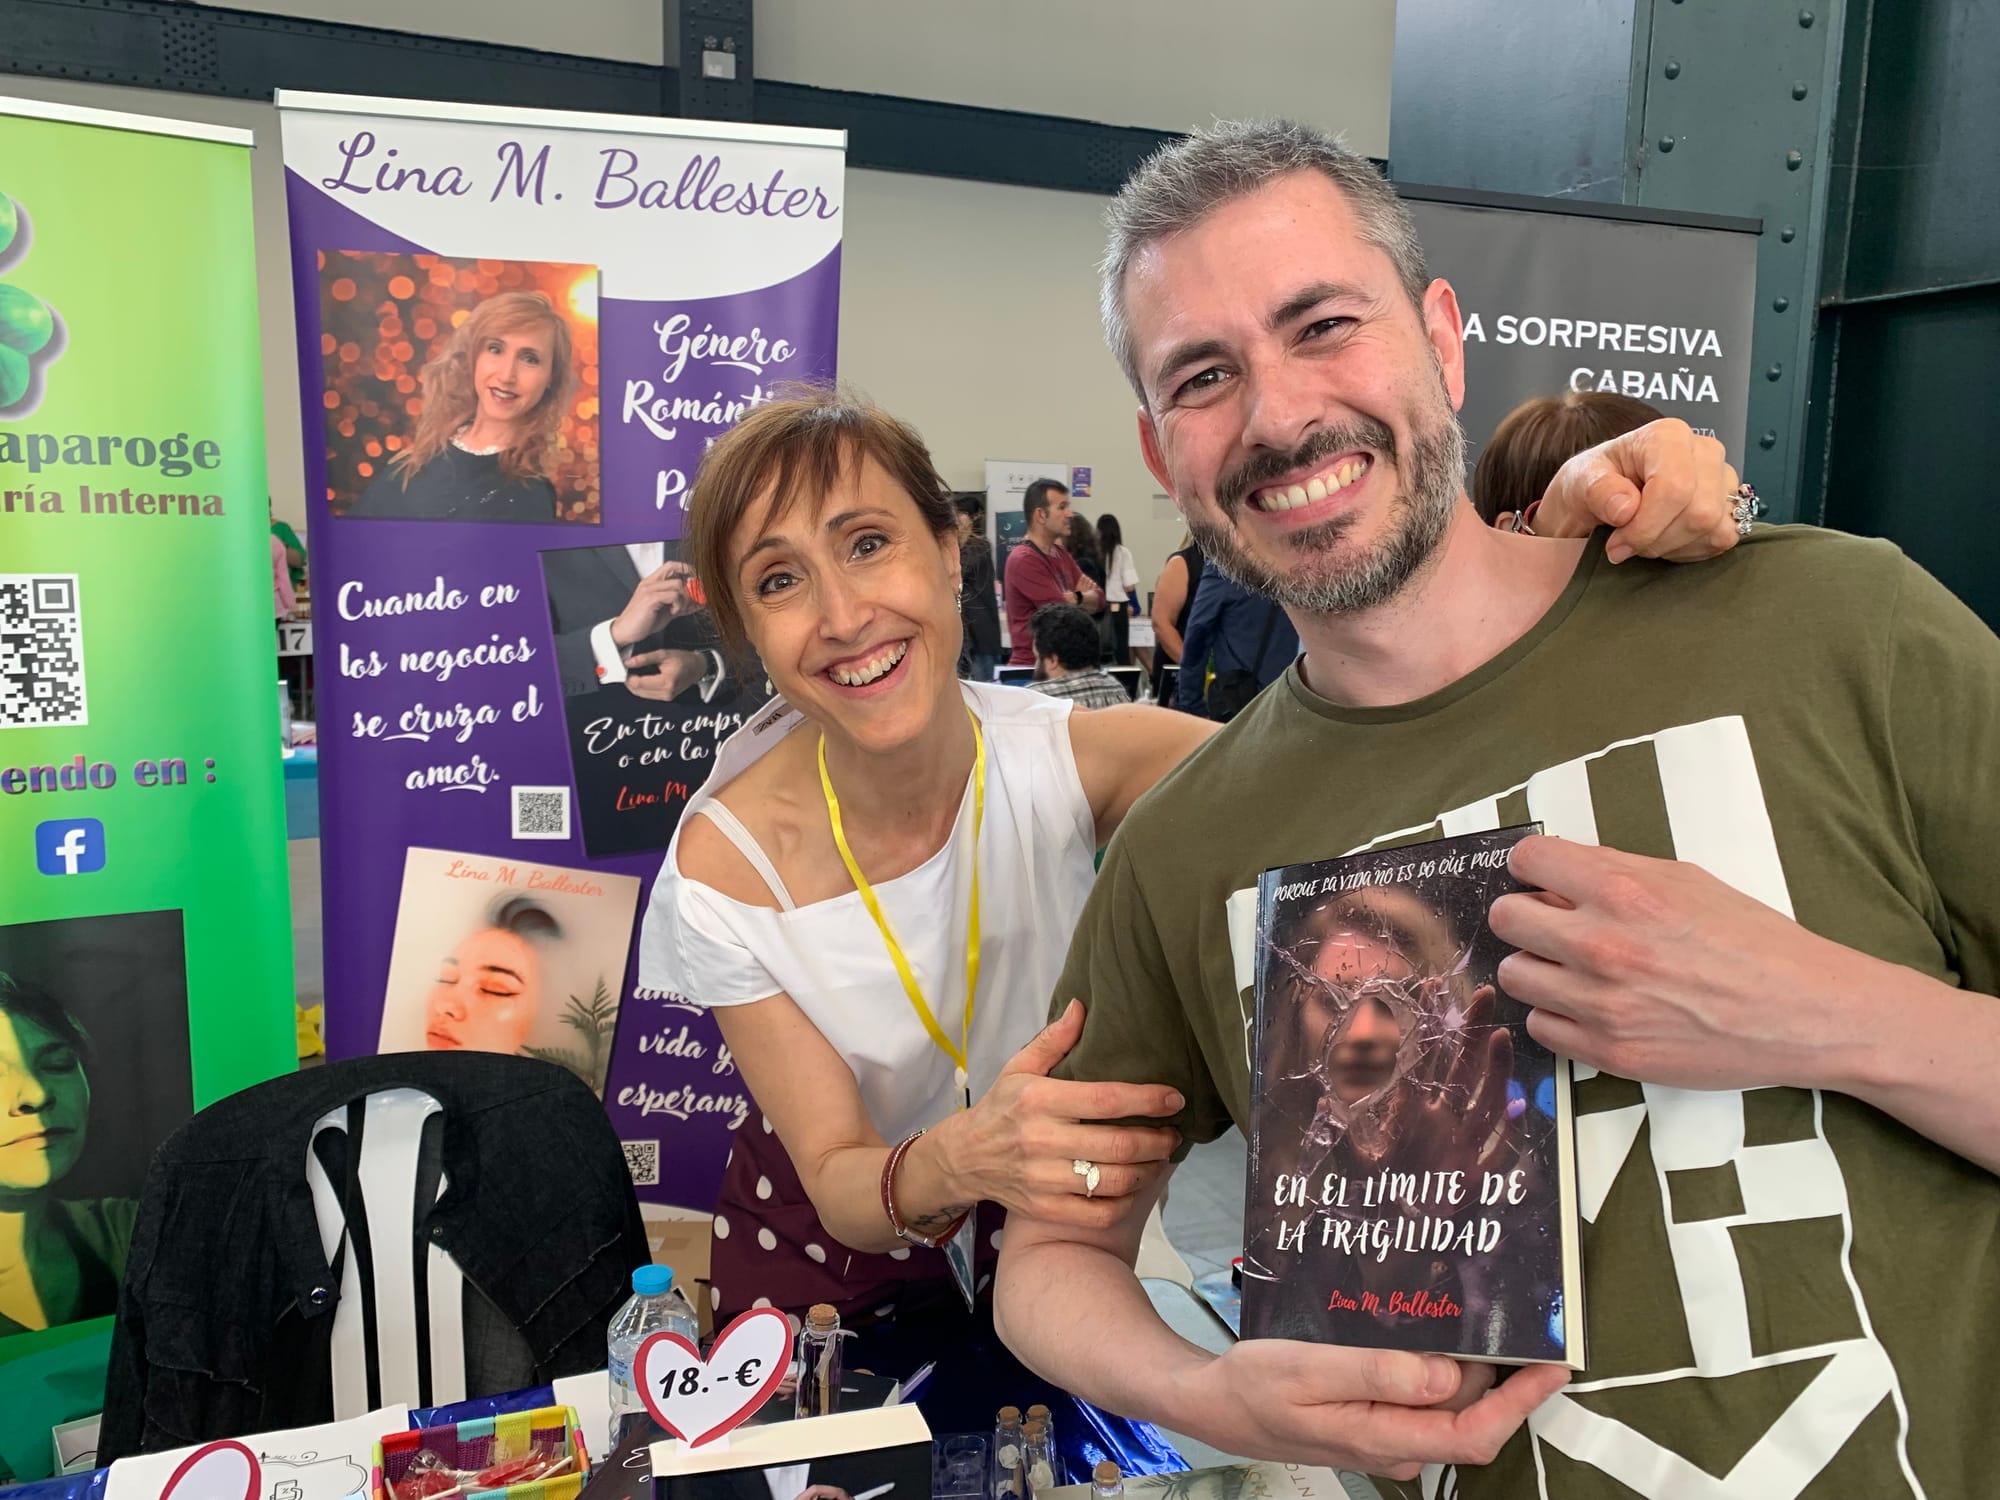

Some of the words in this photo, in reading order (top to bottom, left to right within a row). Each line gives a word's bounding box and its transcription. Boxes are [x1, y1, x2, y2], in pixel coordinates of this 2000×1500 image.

[322, 131, 472, 195] Lina
[490, 141, 563, 205] M.
[594, 148, 838, 220] Ballester
[653, 314, 796, 383] Género
[1462, 313, 1487, 342] A
[1496, 315, 1723, 357] SORPRESIVA
[1570, 367, 1720, 402] CABAÑA
[0, 484, 64, 514] ría
[79, 485, 226, 516] Interna
[337, 576, 469, 621] Cuando
[479, 584, 520, 608] en
[279, 628, 306, 651] 17
[340, 643, 388, 679] los
[400, 634, 537, 682] negocios
[352, 712, 388, 738] se
[398, 703, 501, 743] cruza
[512, 684, 544, 722] el
[583, 716, 636, 755] En
[635, 713, 675, 740] tu
[639, 747, 673, 766] en
[680, 737, 710, 761] la
[134, 758, 187, 787] en
[405, 755, 500, 794] amor.
[445, 860, 491, 881] Lina
[527, 869, 605, 897] Ballester
[1272, 879, 1321, 902] PORQUE
[1338, 867, 1372, 891] VIDA
[1373, 867, 1394, 887] NO
[1397, 863, 1414, 883] ES
[1438, 853, 1467, 876] QUE
[638, 1025, 707, 1059] vida
[617, 1082, 750, 1130] esperanz
[1274, 1173, 1308, 1207] EN
[1322, 1173, 1350, 1207] EL
[1362, 1167, 1467, 1207] LÍMITE
[1480, 1170, 1528, 1206] DE
[1276, 1220, 1307, 1253] LA
[1321, 1216, 1503, 1263] FRAGILIDAD
[1328, 1290, 1358, 1312] Lina
[1389, 1291, 1463, 1318] Ballester
